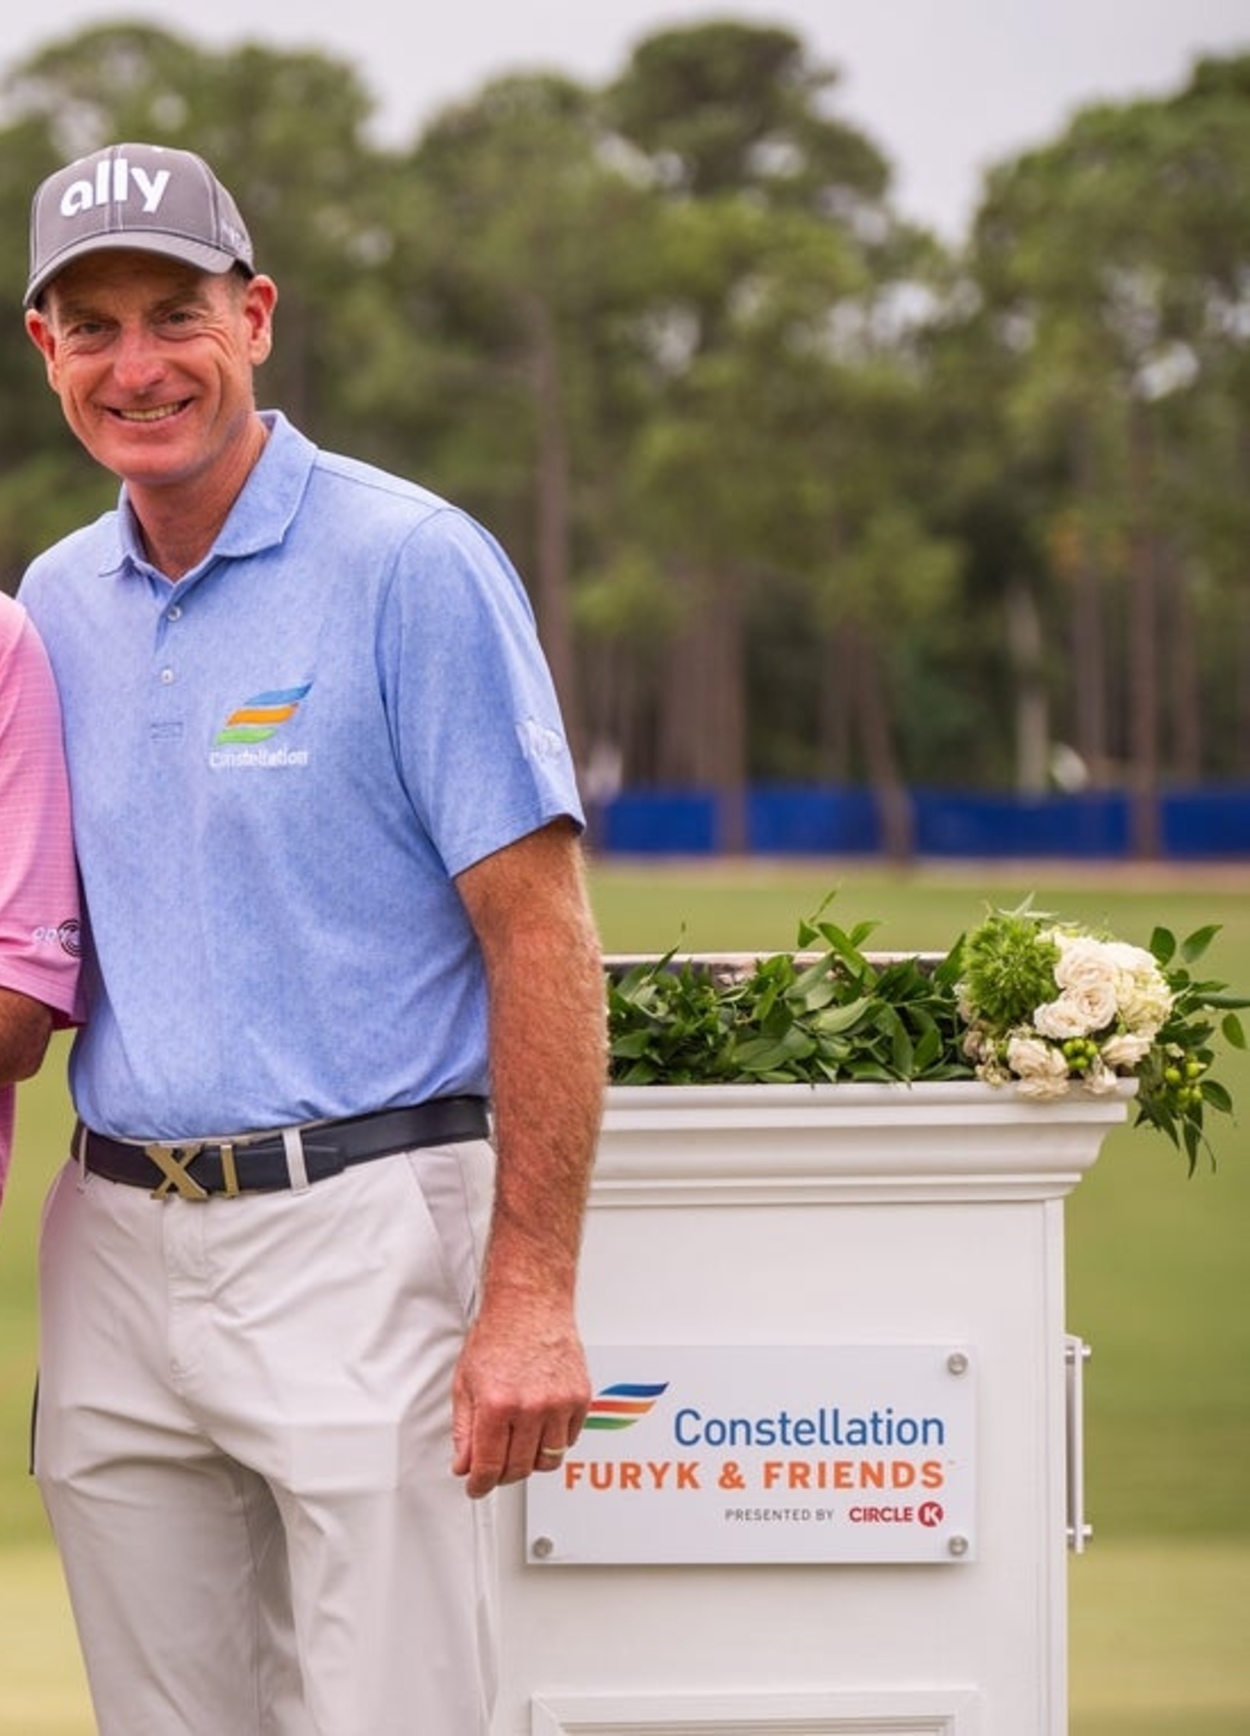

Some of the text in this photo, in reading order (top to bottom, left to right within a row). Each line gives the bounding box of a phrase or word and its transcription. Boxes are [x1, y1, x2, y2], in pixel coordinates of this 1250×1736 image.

[60, 158, 171, 217] ally
[674, 1407, 945, 1447] Constellation
[565, 1460, 944, 1490] FURYK & FRIENDS
[725, 1502, 944, 1527] PRESENTED BY CIRCLE K
